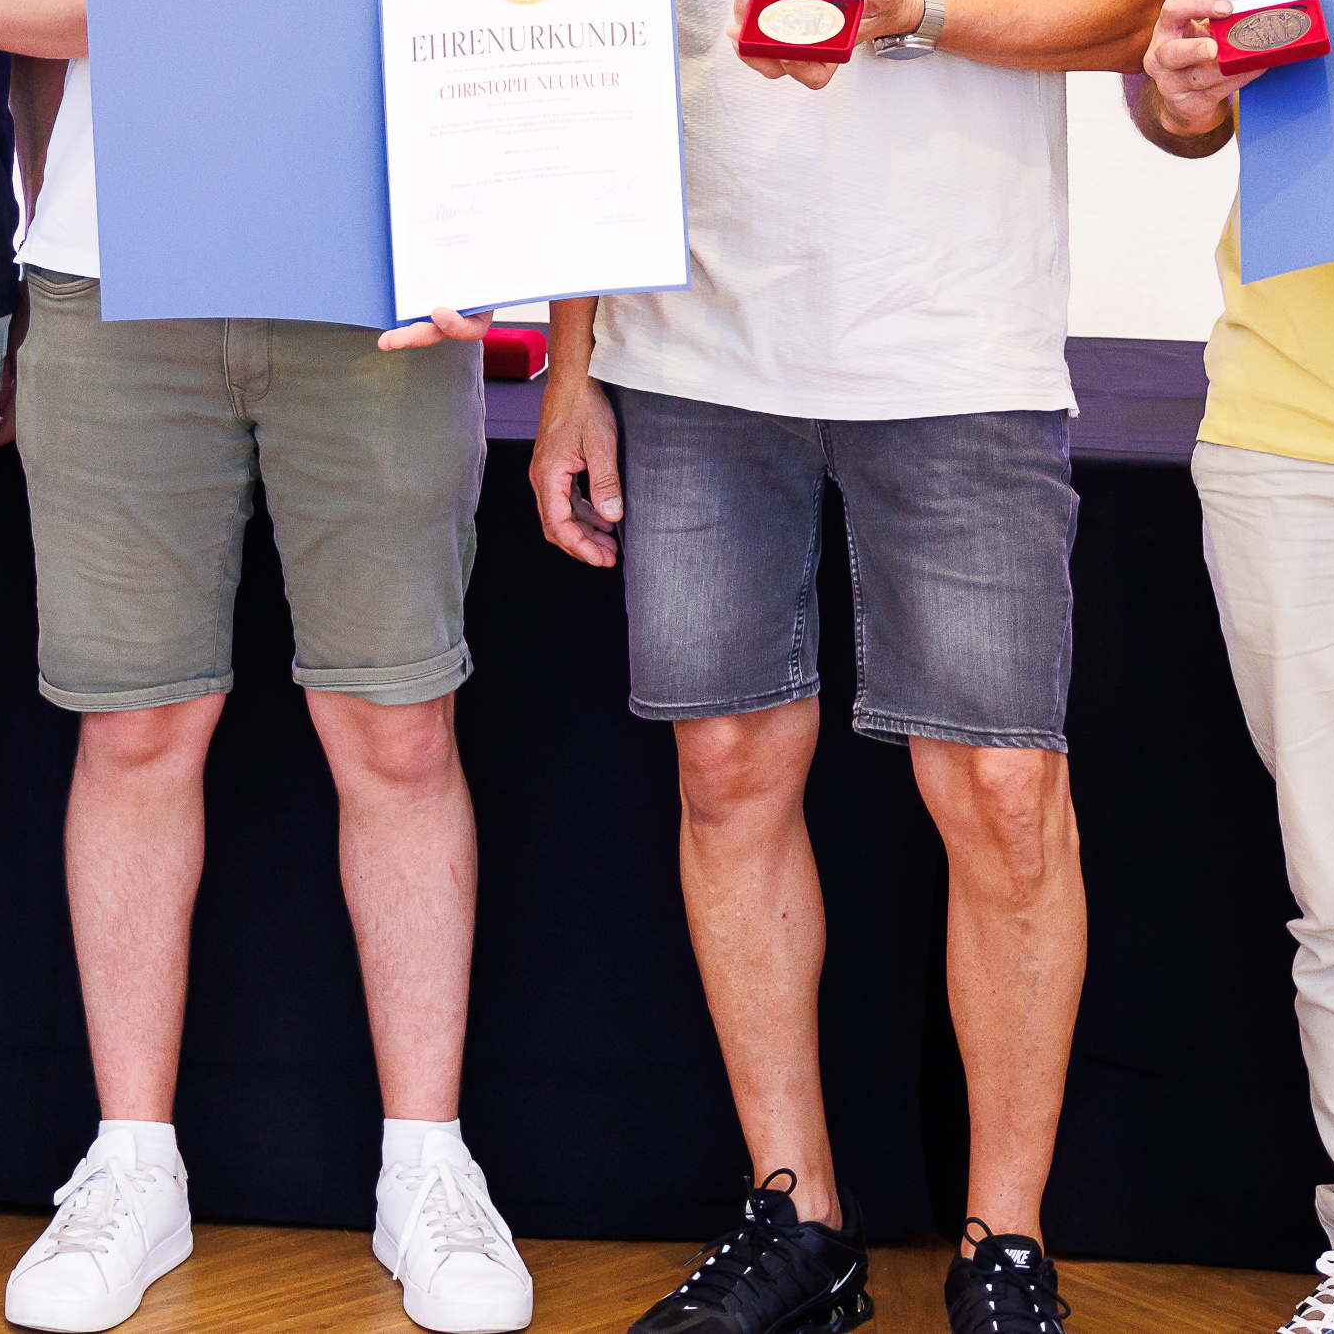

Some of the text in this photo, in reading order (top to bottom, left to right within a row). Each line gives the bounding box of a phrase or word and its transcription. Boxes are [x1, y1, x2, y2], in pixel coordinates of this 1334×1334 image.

[411, 21, 647, 63] EHRENURKUNDE
[439, 72, 620, 101] CHRISTOPH NEUBAUER
